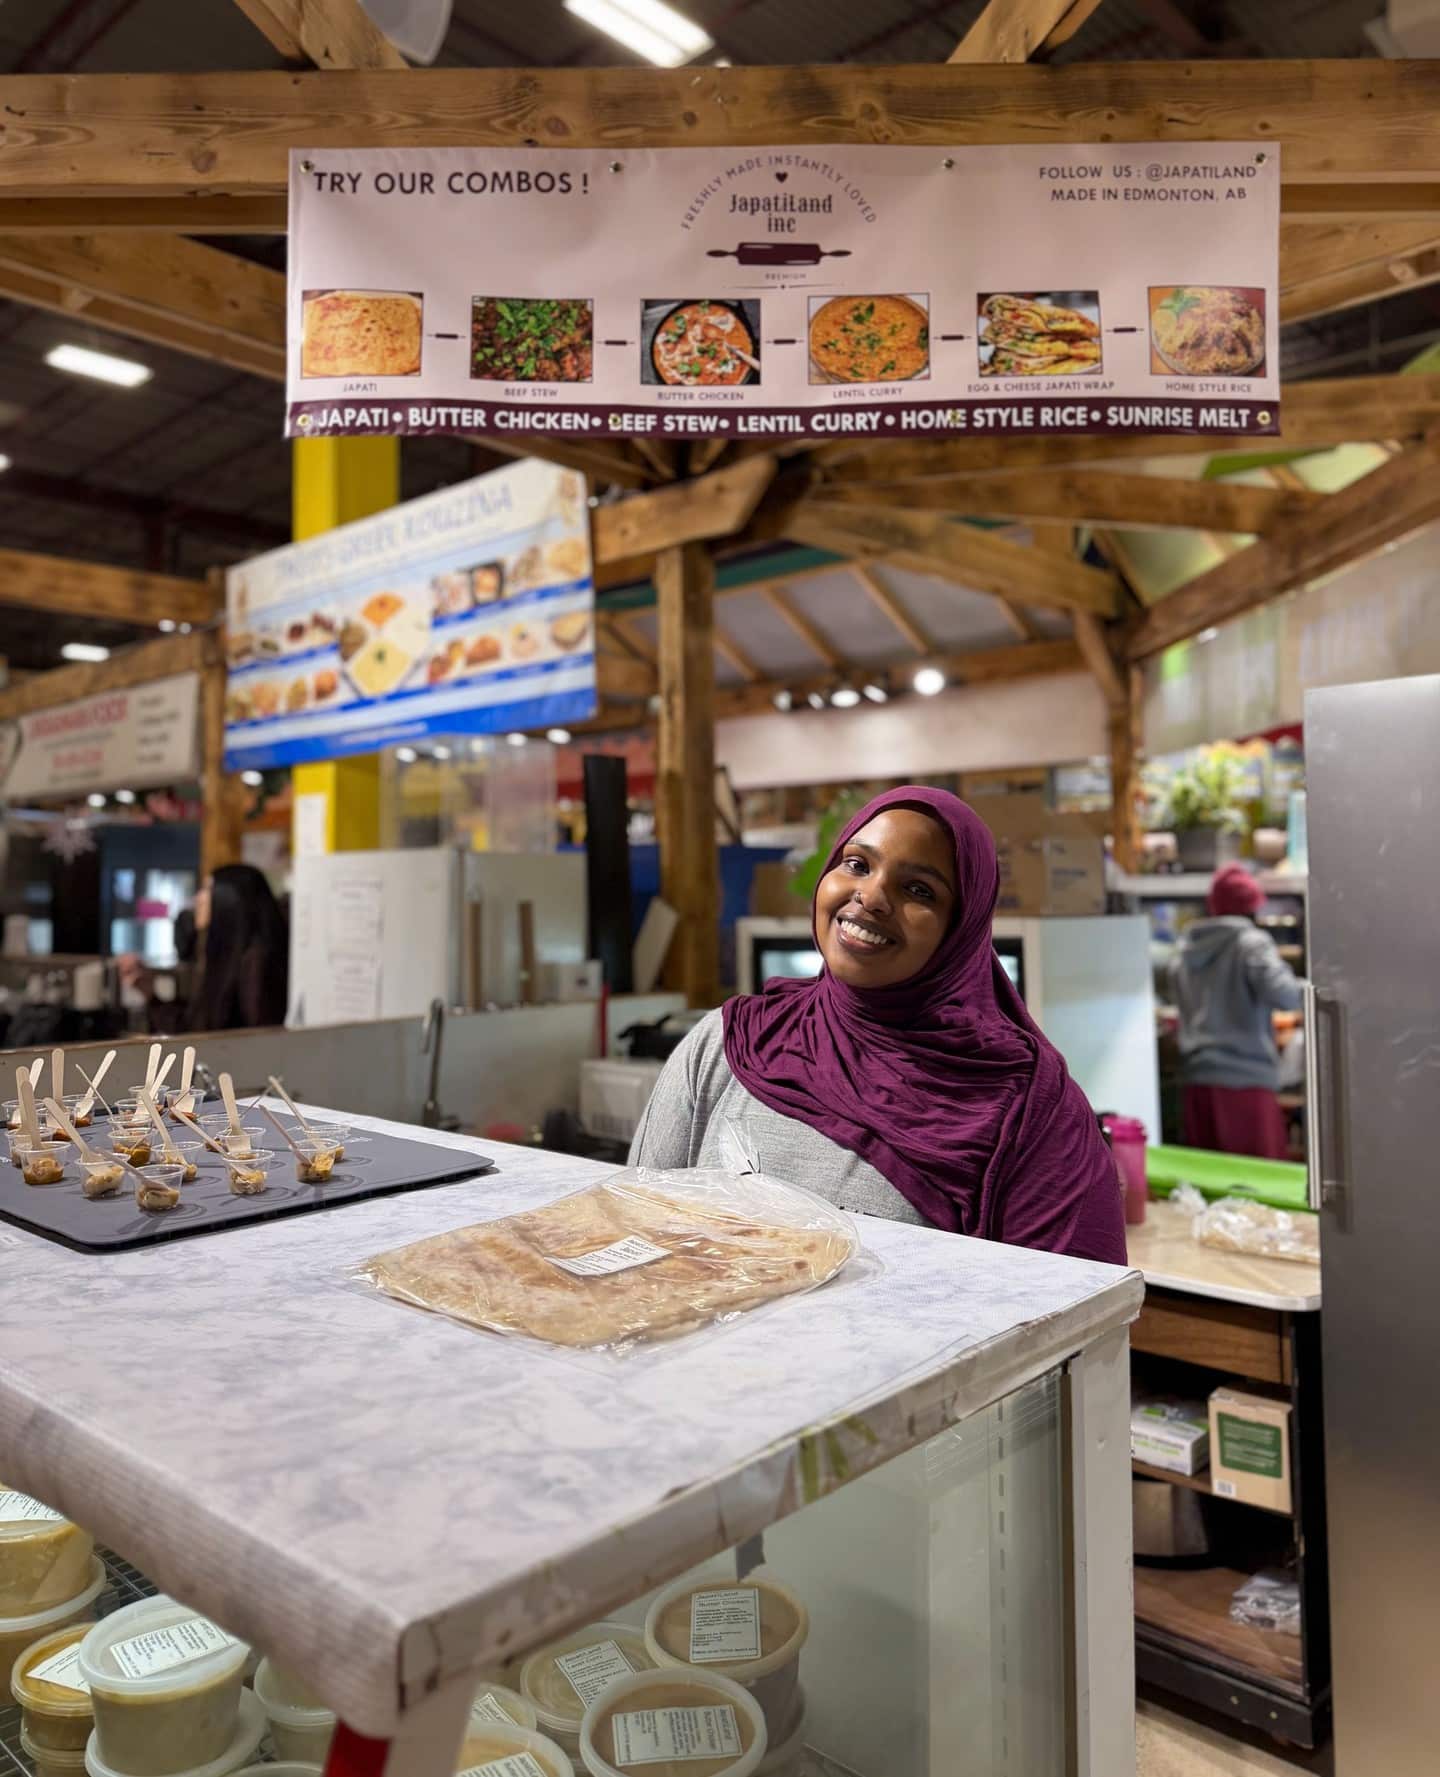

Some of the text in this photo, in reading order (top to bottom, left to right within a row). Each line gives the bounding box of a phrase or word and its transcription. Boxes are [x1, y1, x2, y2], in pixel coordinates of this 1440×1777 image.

[1039, 166, 1103, 179] FOLLOW
[1112, 165, 1132, 178] US
[1146, 164, 1257, 182] @JAPATILAND
[314, 172, 362, 194] TRY
[374, 172, 435, 195] OUR
[447, 170, 573, 195] COMBOS
[681, 155, 877, 230] FRESHLY MADE INSTANTLY LOVED
[1051, 187, 1247, 204] MADE IN EDMONTON, AB
[767, 214, 797, 233] inc
[343, 382, 378, 392] JAPATI
[504, 387, 559, 397] BEEF STEW
[833, 387, 903, 399] LENTIL CURRY
[967, 381, 1115, 393] EGG & CHEESE JAPATI WRAP
[1165, 382, 1252, 393] HOME STYLE RICE
[657, 391, 745, 401] BUTTER CHICKEN
[317, 407, 388, 428] JAPATI
[408, 407, 487, 428] BUTTER
[494, 410, 590, 431] CHICKEN
[663, 414, 719, 433] STEW
[737, 415, 806, 433] LENTIL
[810, 411, 881, 432] CURRY
[901, 408, 967, 429] HOME
[973, 407, 1035, 428] STYLE
[1040, 406, 1088, 426] RICE
[1107, 406, 1193, 427] SUNRISE
[1199, 408, 1250, 428] MELT
